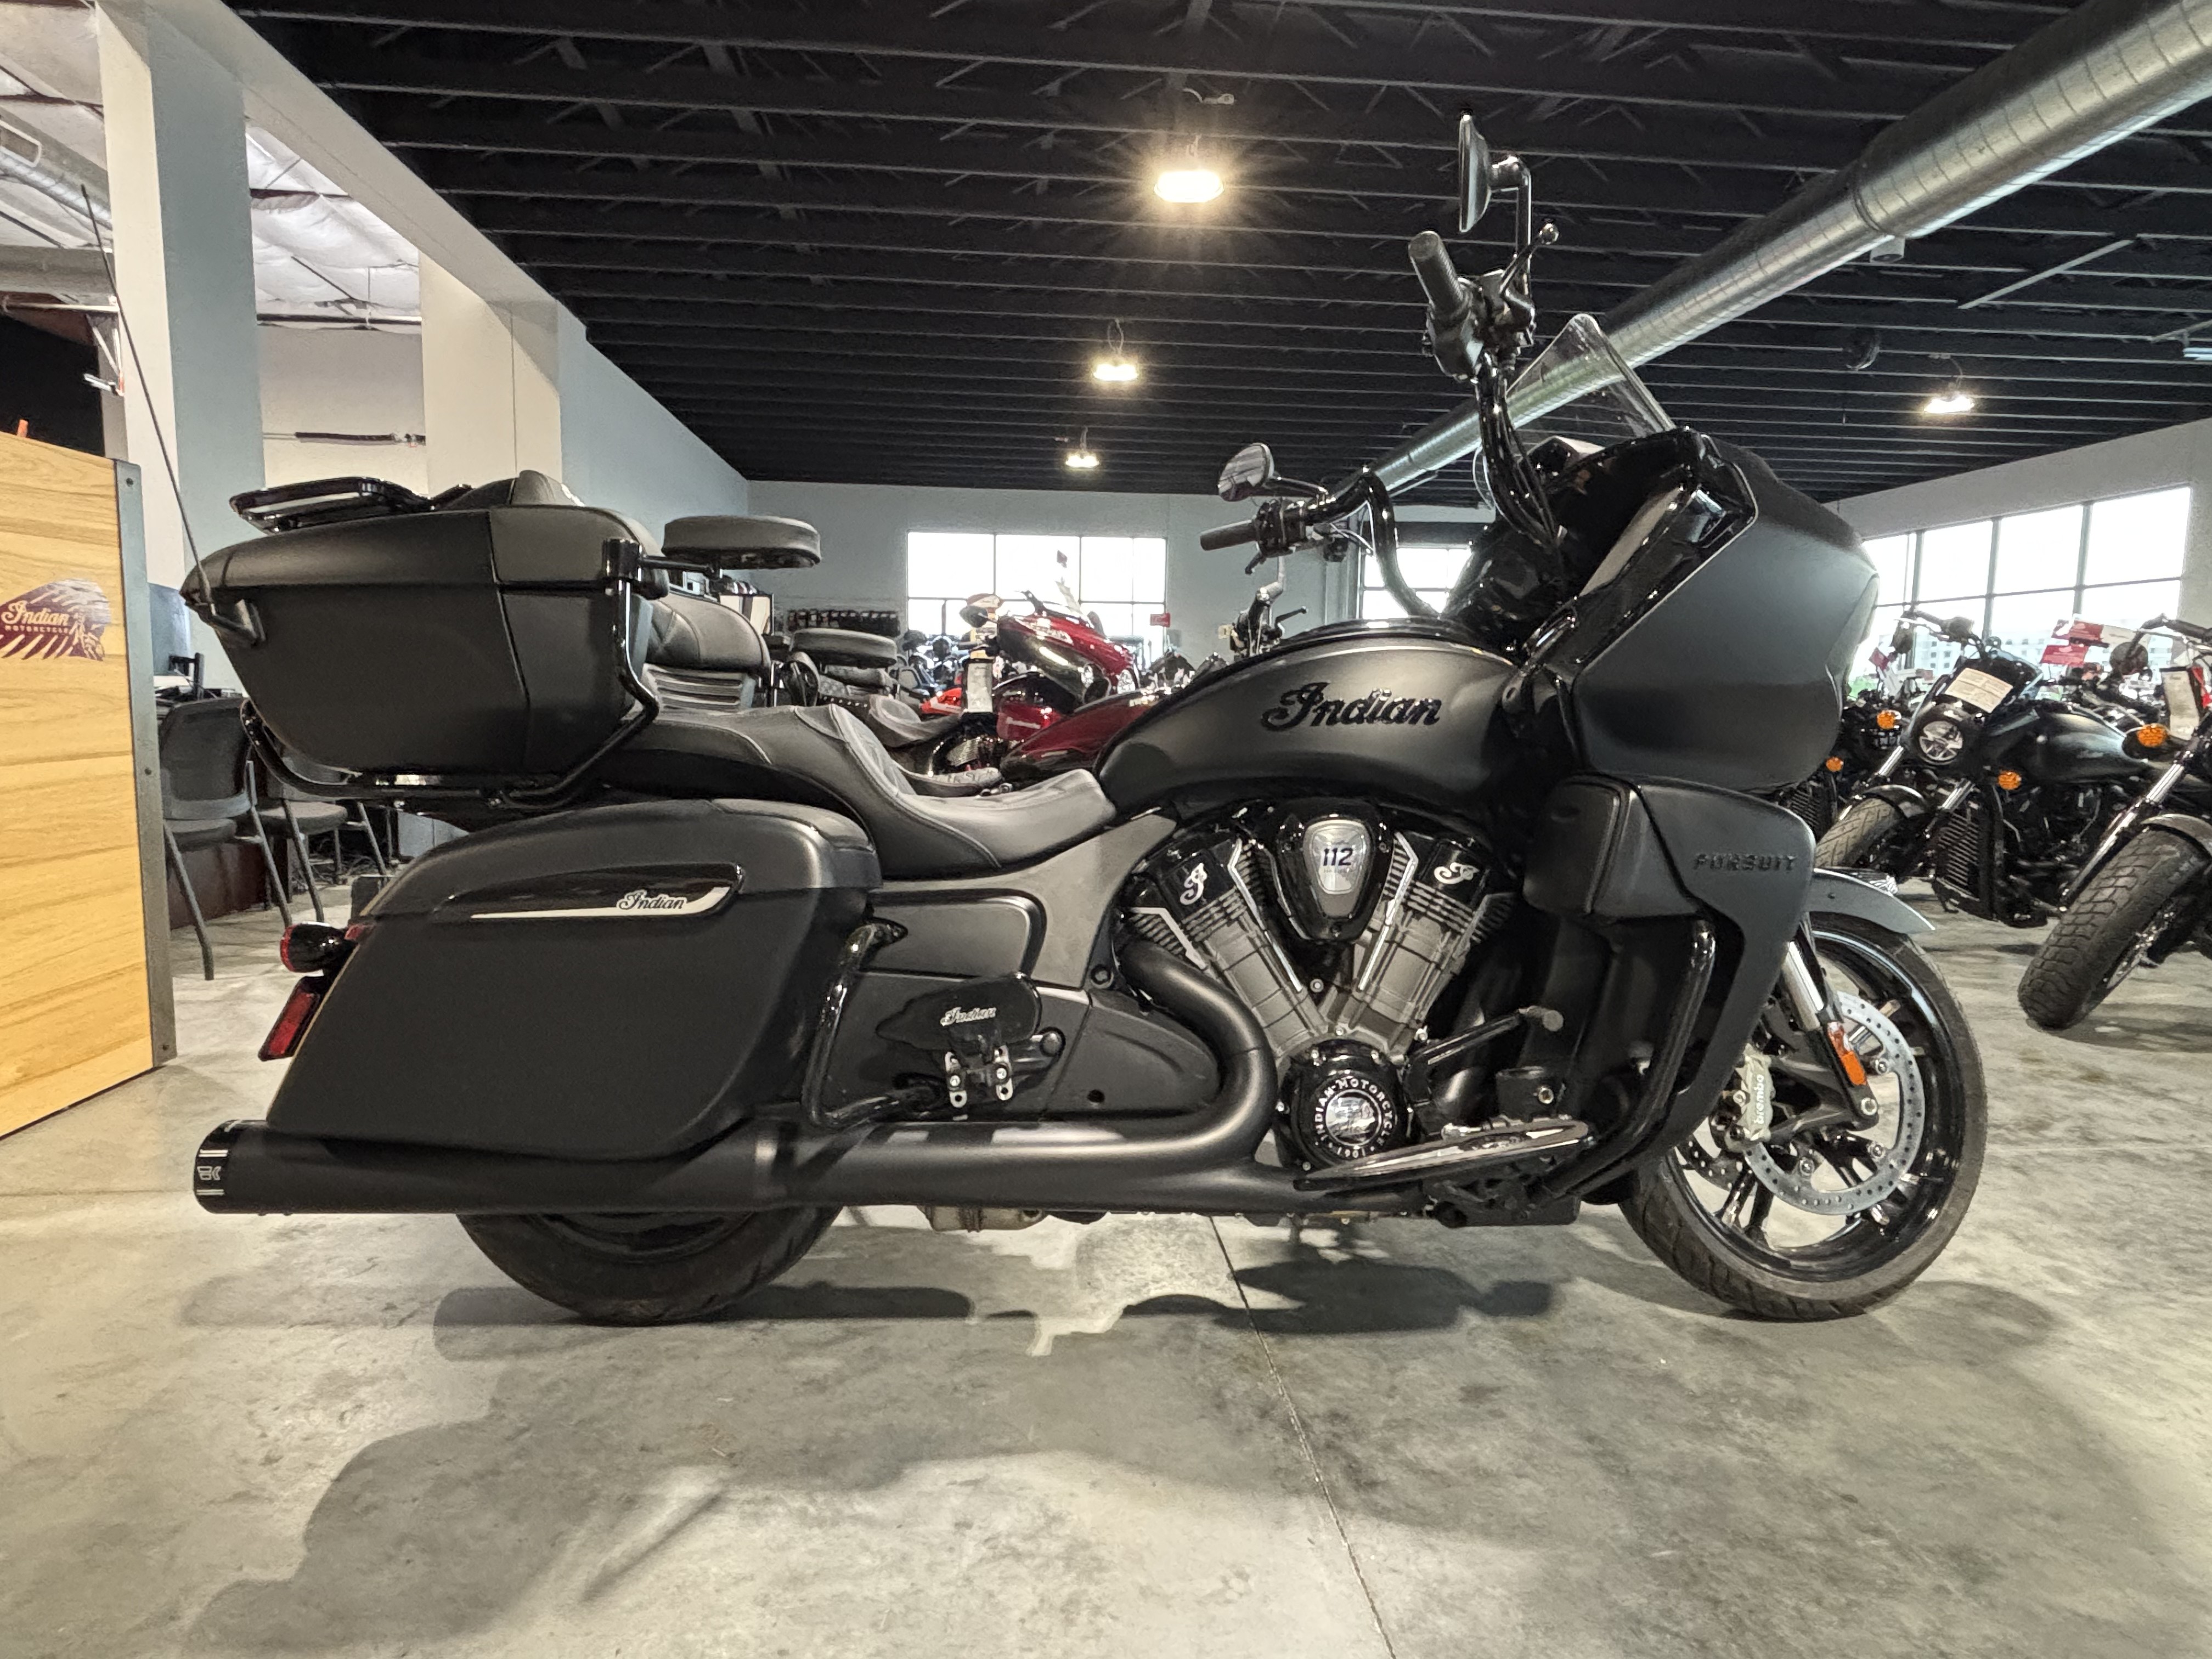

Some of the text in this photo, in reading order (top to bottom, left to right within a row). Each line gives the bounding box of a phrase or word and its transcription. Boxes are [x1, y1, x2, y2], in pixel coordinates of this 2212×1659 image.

[1, 600, 69, 625] Indian
[1262, 681, 1442, 732] Indian
[1323, 847, 1353, 866] 112
[1694, 853, 1797, 871] PURSUIT
[617, 890, 686, 911] Indian
[940, 1006, 996, 1026] Indian
[1753, 1074, 1764, 1125] brembo
[1314, 1077, 1392, 1146] INDIAN MOTORCYCLE
